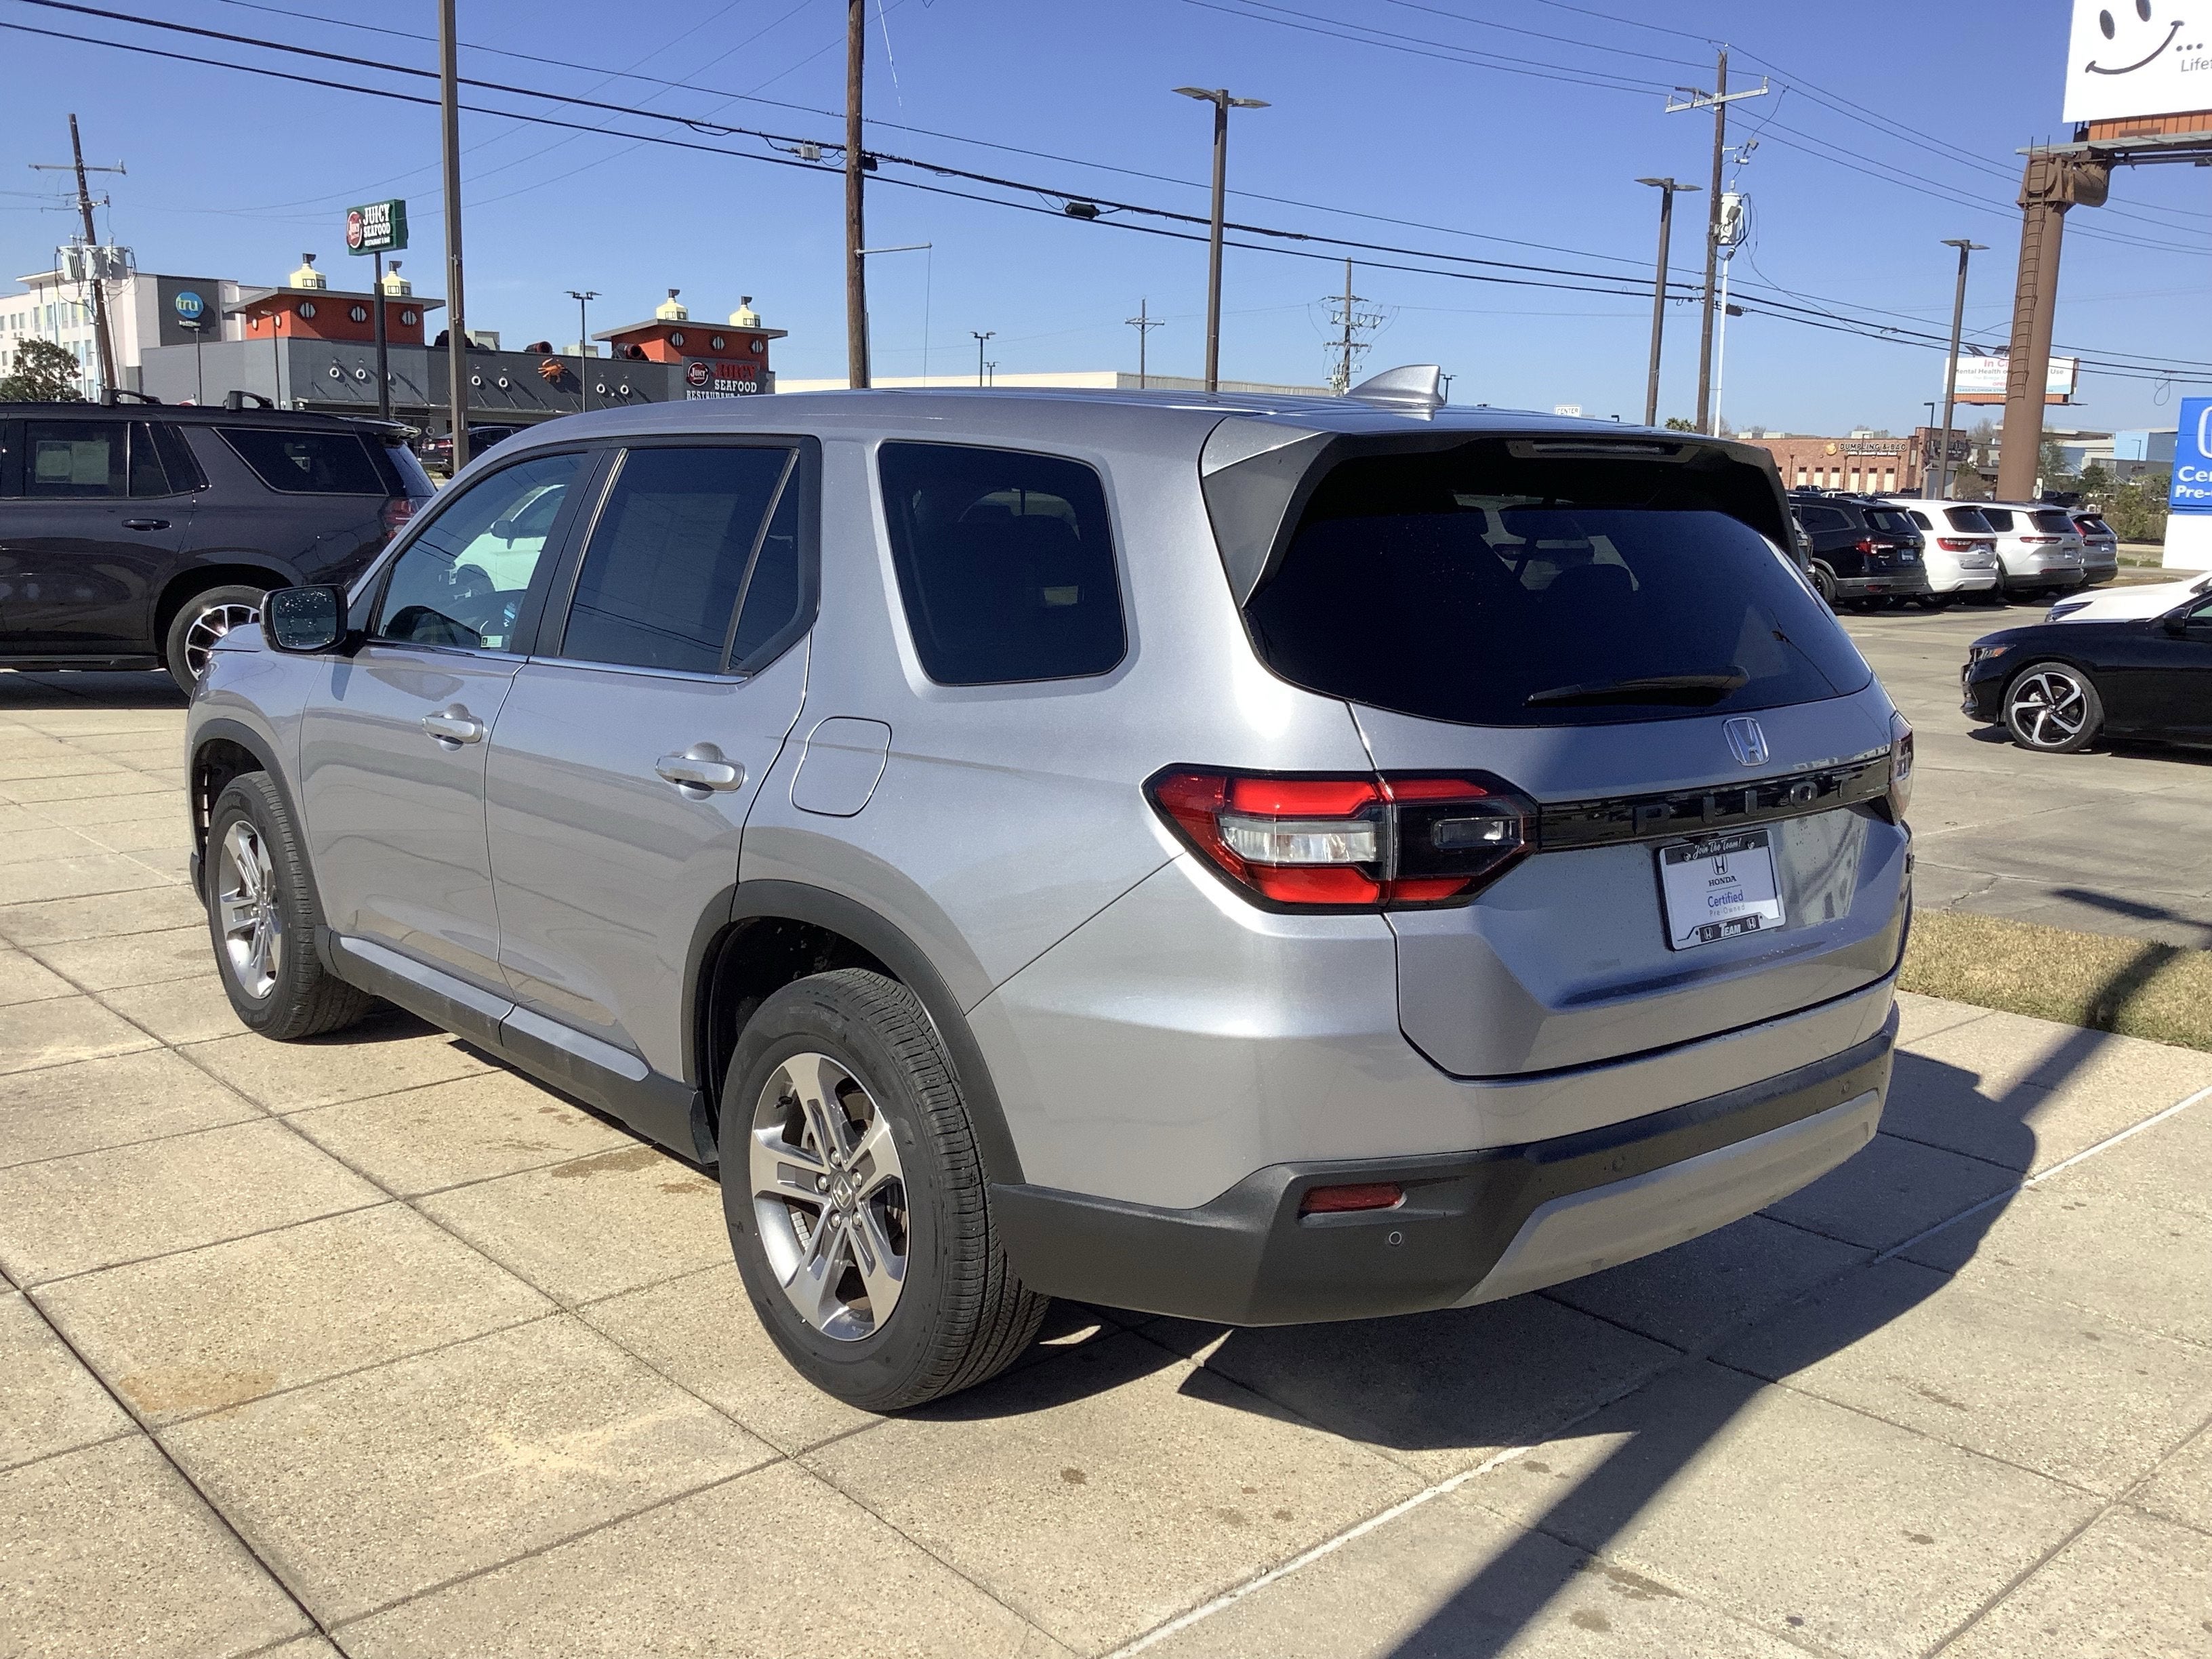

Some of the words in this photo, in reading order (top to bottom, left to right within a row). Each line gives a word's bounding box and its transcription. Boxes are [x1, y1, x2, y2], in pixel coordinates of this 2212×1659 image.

[363, 203, 390, 225] JUICY
[363, 222, 391, 238] SEAFOOD
[178, 297, 199, 311] tru
[1984, 359, 1994, 367] In
[712, 362, 755, 381] JUICY
[715, 380, 757, 393] SEAFOOD
[2175, 485, 2212, 499] Pre-
[1632, 773, 1853, 835] PILOT
[1693, 844, 1708, 859] Join
[1708, 840, 1721, 852] The
[1721, 838, 1742, 851] Team!
[1708, 876, 1737, 886] HONDA
[1707, 889, 1744, 907] Certified
